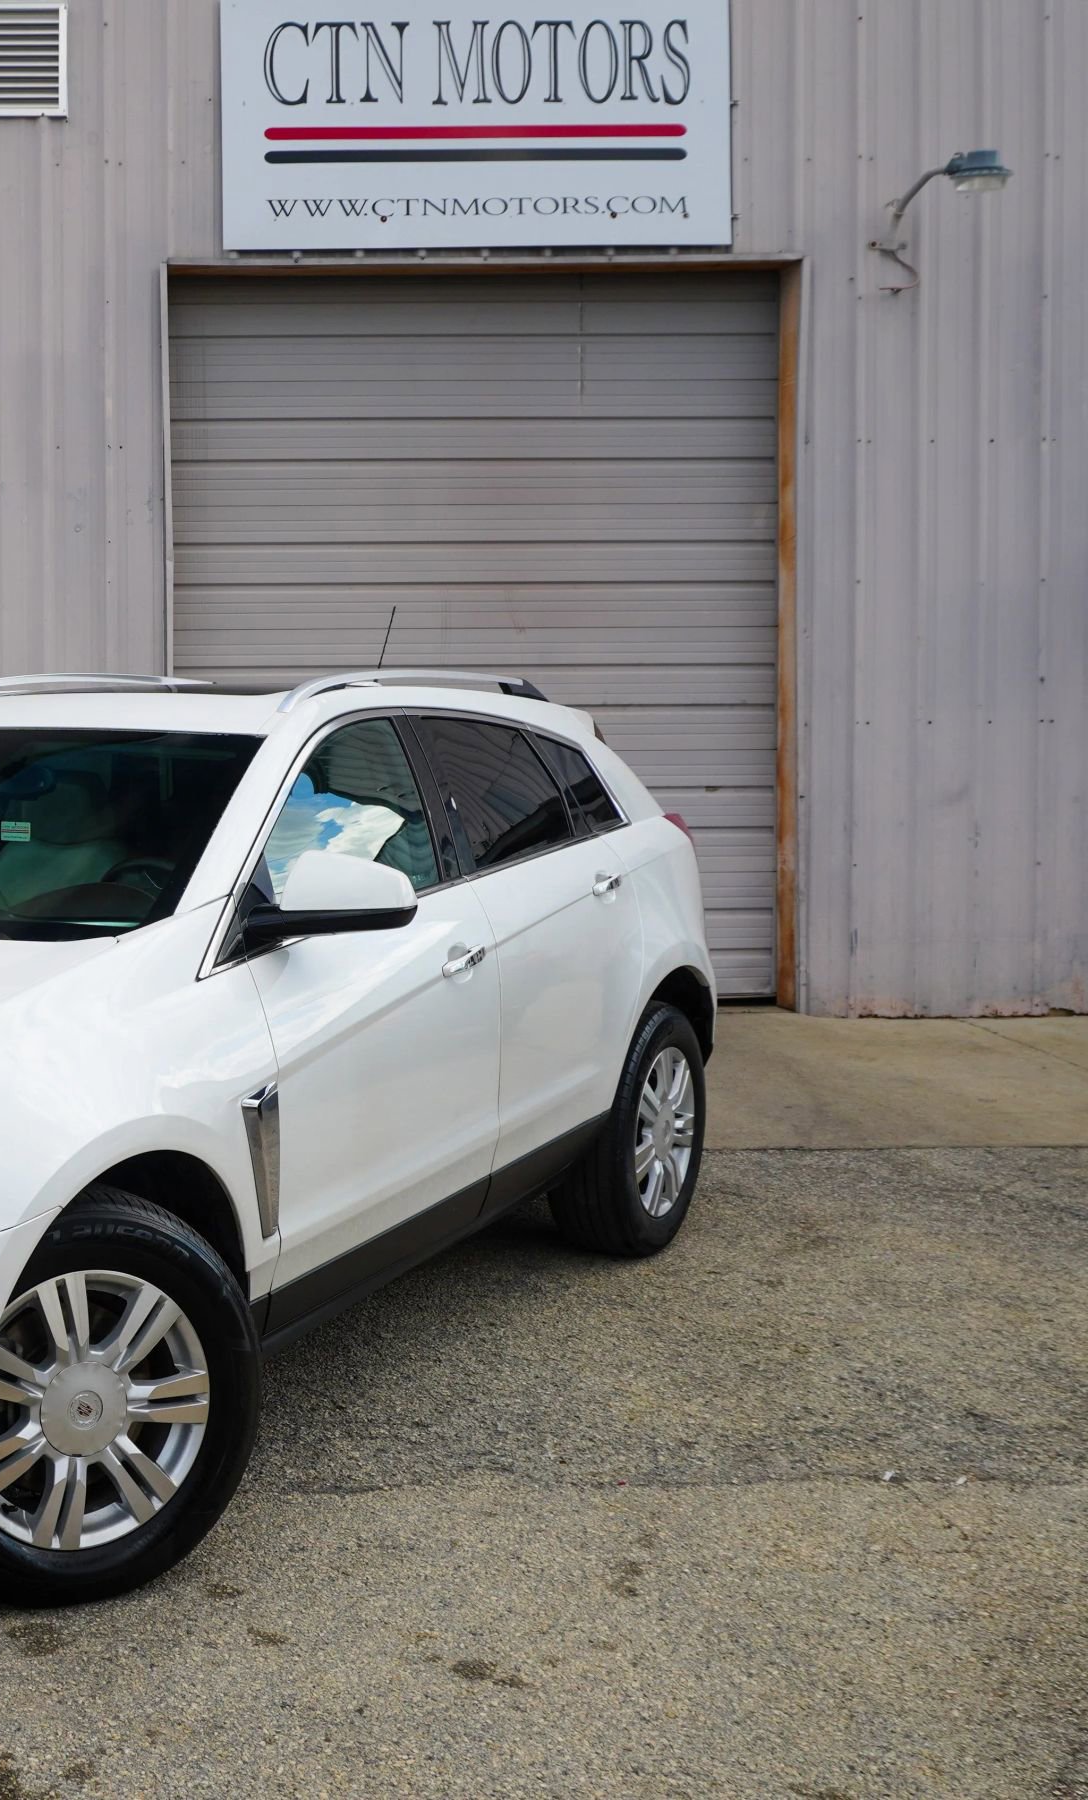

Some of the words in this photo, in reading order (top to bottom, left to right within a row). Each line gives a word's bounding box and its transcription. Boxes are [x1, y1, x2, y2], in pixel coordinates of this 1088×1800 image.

[263, 21, 410, 105] CTN
[432, 19, 690, 105] MOTORS
[266, 195, 688, 217] WWW.CTNMOTORS.COM
